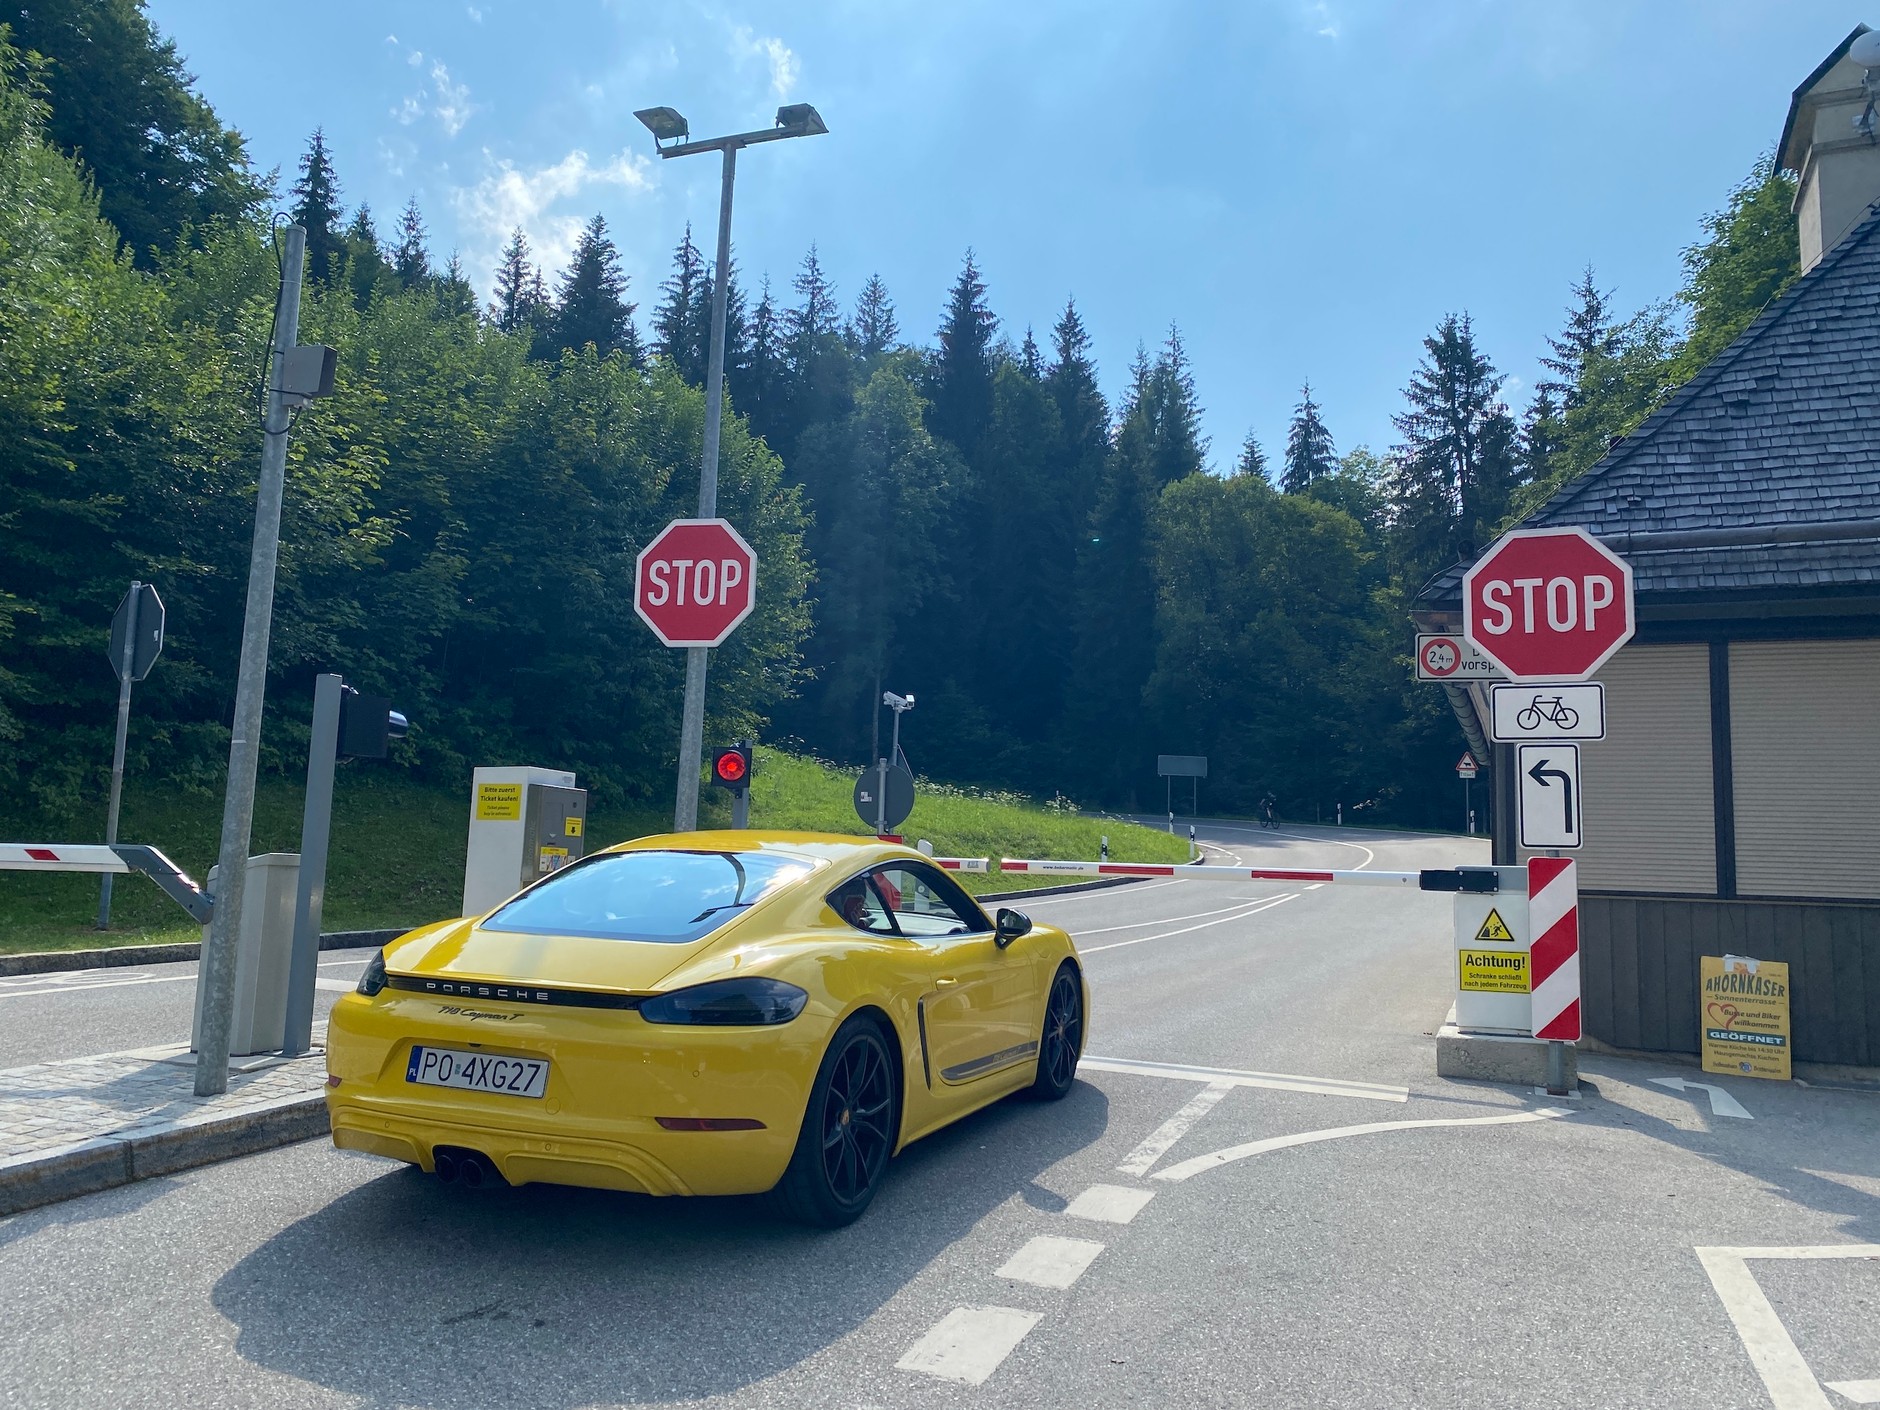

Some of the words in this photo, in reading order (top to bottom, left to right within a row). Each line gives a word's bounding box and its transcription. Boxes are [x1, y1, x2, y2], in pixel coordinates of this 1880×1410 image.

[647, 559, 742, 606] STOP
[1482, 574, 1614, 635] STOP
[1461, 661, 1498, 673] vorsp
[1465, 954, 1525, 971] Achtung!
[426, 982, 548, 1000] PORSCHE
[1500, 982, 1527, 990] Fahrzeug
[1706, 974, 1786, 998] AHORNKASER
[1714, 994, 1776, 1006] Sonnenterrasse
[460, 1008, 508, 1021] Cayman
[1762, 1012, 1781, 1020] Biker
[1734, 1020, 1780, 1030] willkommen
[1710, 1031, 1783, 1044] GEÖFFNET
[408, 1068, 416, 1076] PL
[422, 1052, 453, 1082] PO
[461, 1057, 541, 1092] 4XG27
